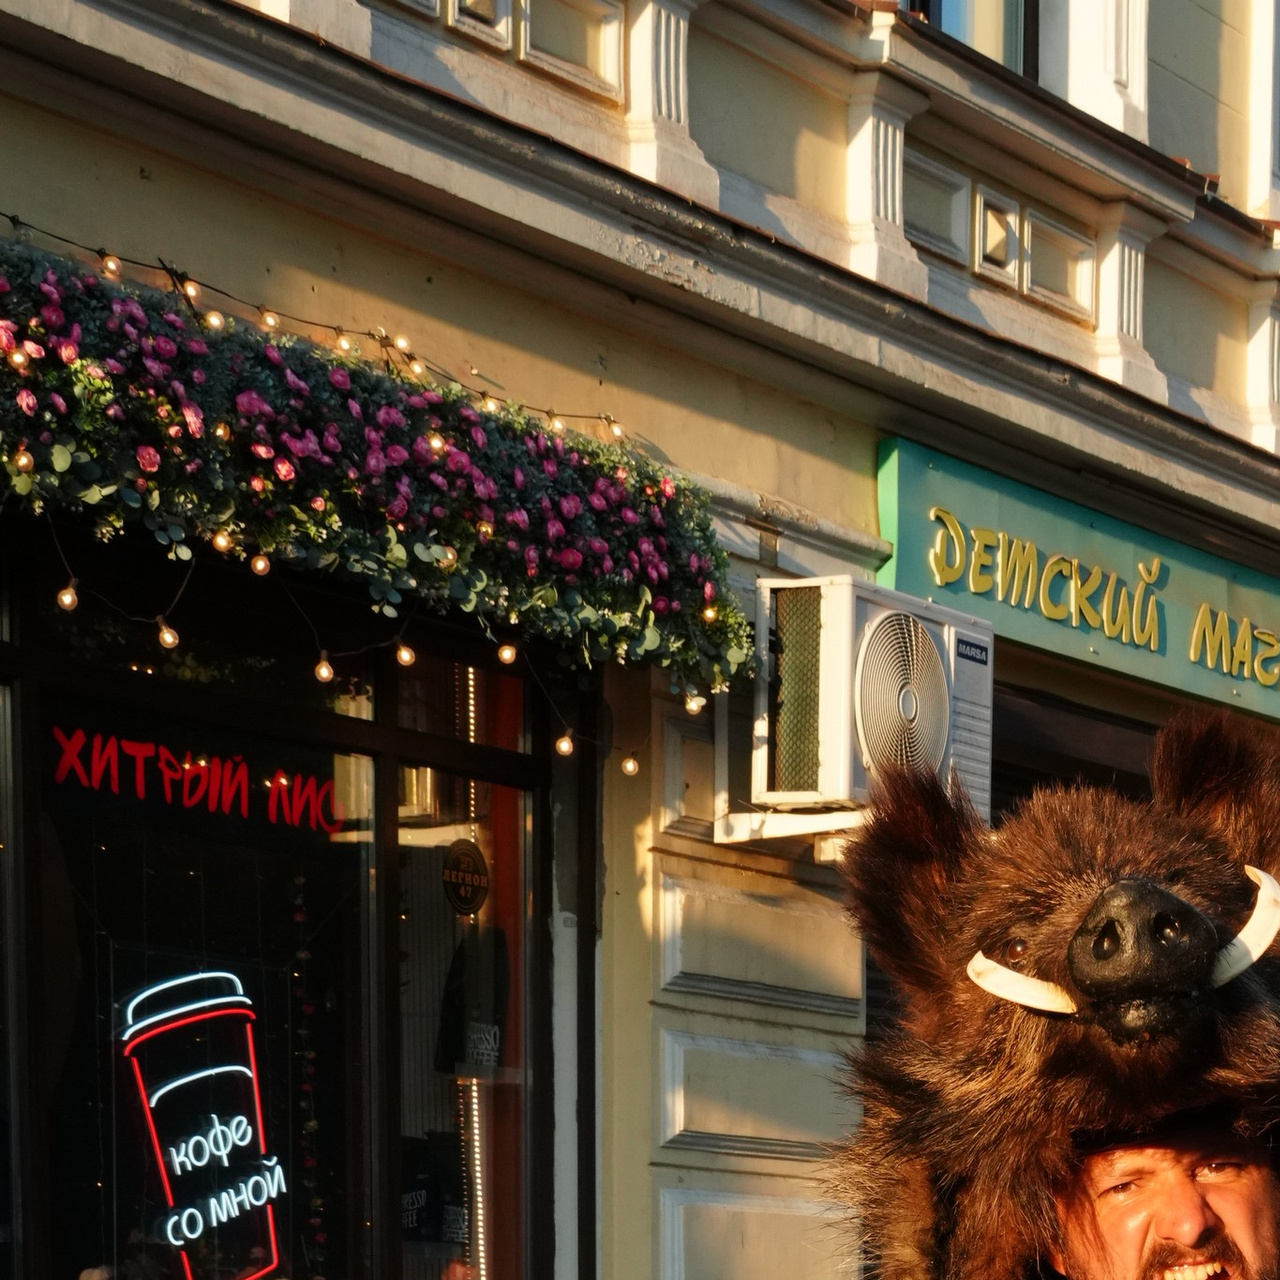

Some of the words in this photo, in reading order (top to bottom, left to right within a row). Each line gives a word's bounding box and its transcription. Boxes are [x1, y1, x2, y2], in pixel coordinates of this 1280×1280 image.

[958, 643, 987, 661] MARSA
[52, 725, 249, 819] ХИТРЫЙ
[268, 768, 344, 834] ЛИС
[443, 869, 488, 887] ЛЕГИОН
[170, 1114, 253, 1175] кофе
